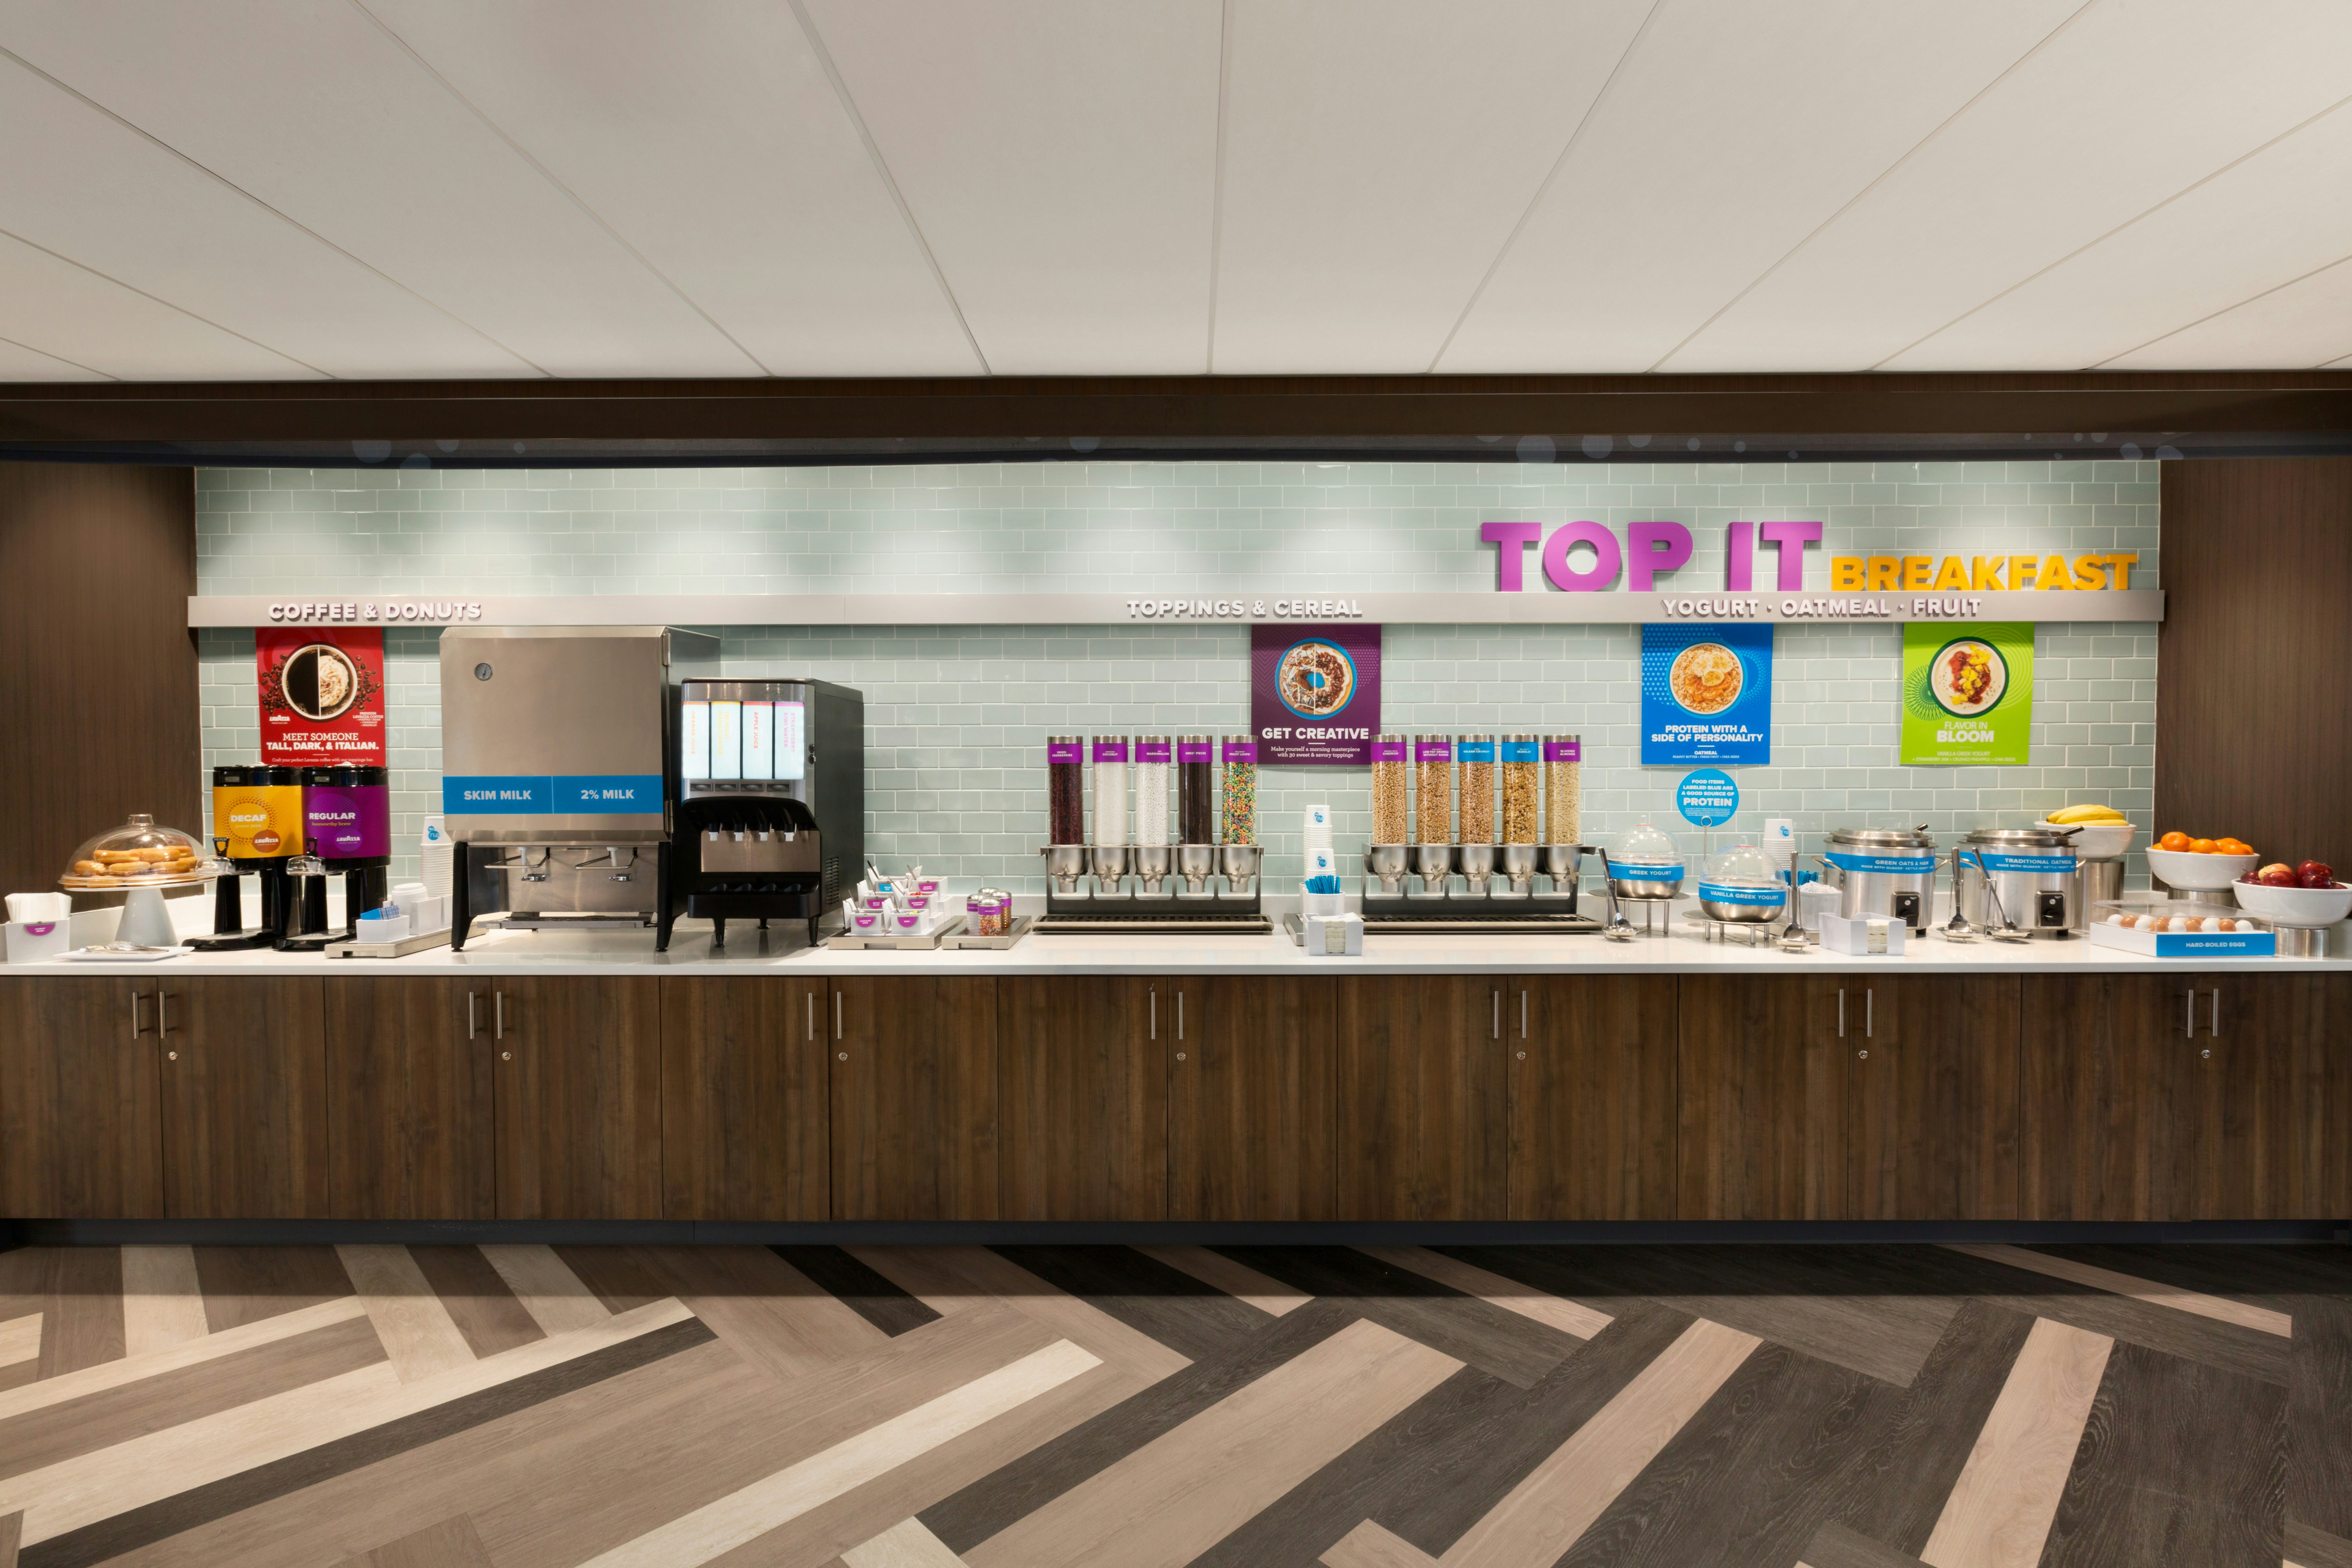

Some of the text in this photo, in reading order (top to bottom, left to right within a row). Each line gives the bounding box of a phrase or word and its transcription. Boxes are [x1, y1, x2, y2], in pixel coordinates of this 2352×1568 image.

[1482, 521, 1823, 592] TOP IT
[1831, 554, 2137, 591] BREAKFAST
[269, 603, 481, 619] COFFEE & DONUTS
[1127, 600, 1362, 617] TOPPINGS & CEREAL
[1662, 599, 1981, 616] YOGURT OATMEAL FRUIT
[1262, 728, 1369, 739] GET CREATIVE
[1936, 730, 1994, 742] BLOOM
[267, 742, 292, 751] TALL,
[294, 742, 324, 751] DARK,
[464, 790, 532, 800] SKIM MILK
[581, 789, 634, 799] 2% MILK
[1683, 797, 1732, 806] PROTEIN
